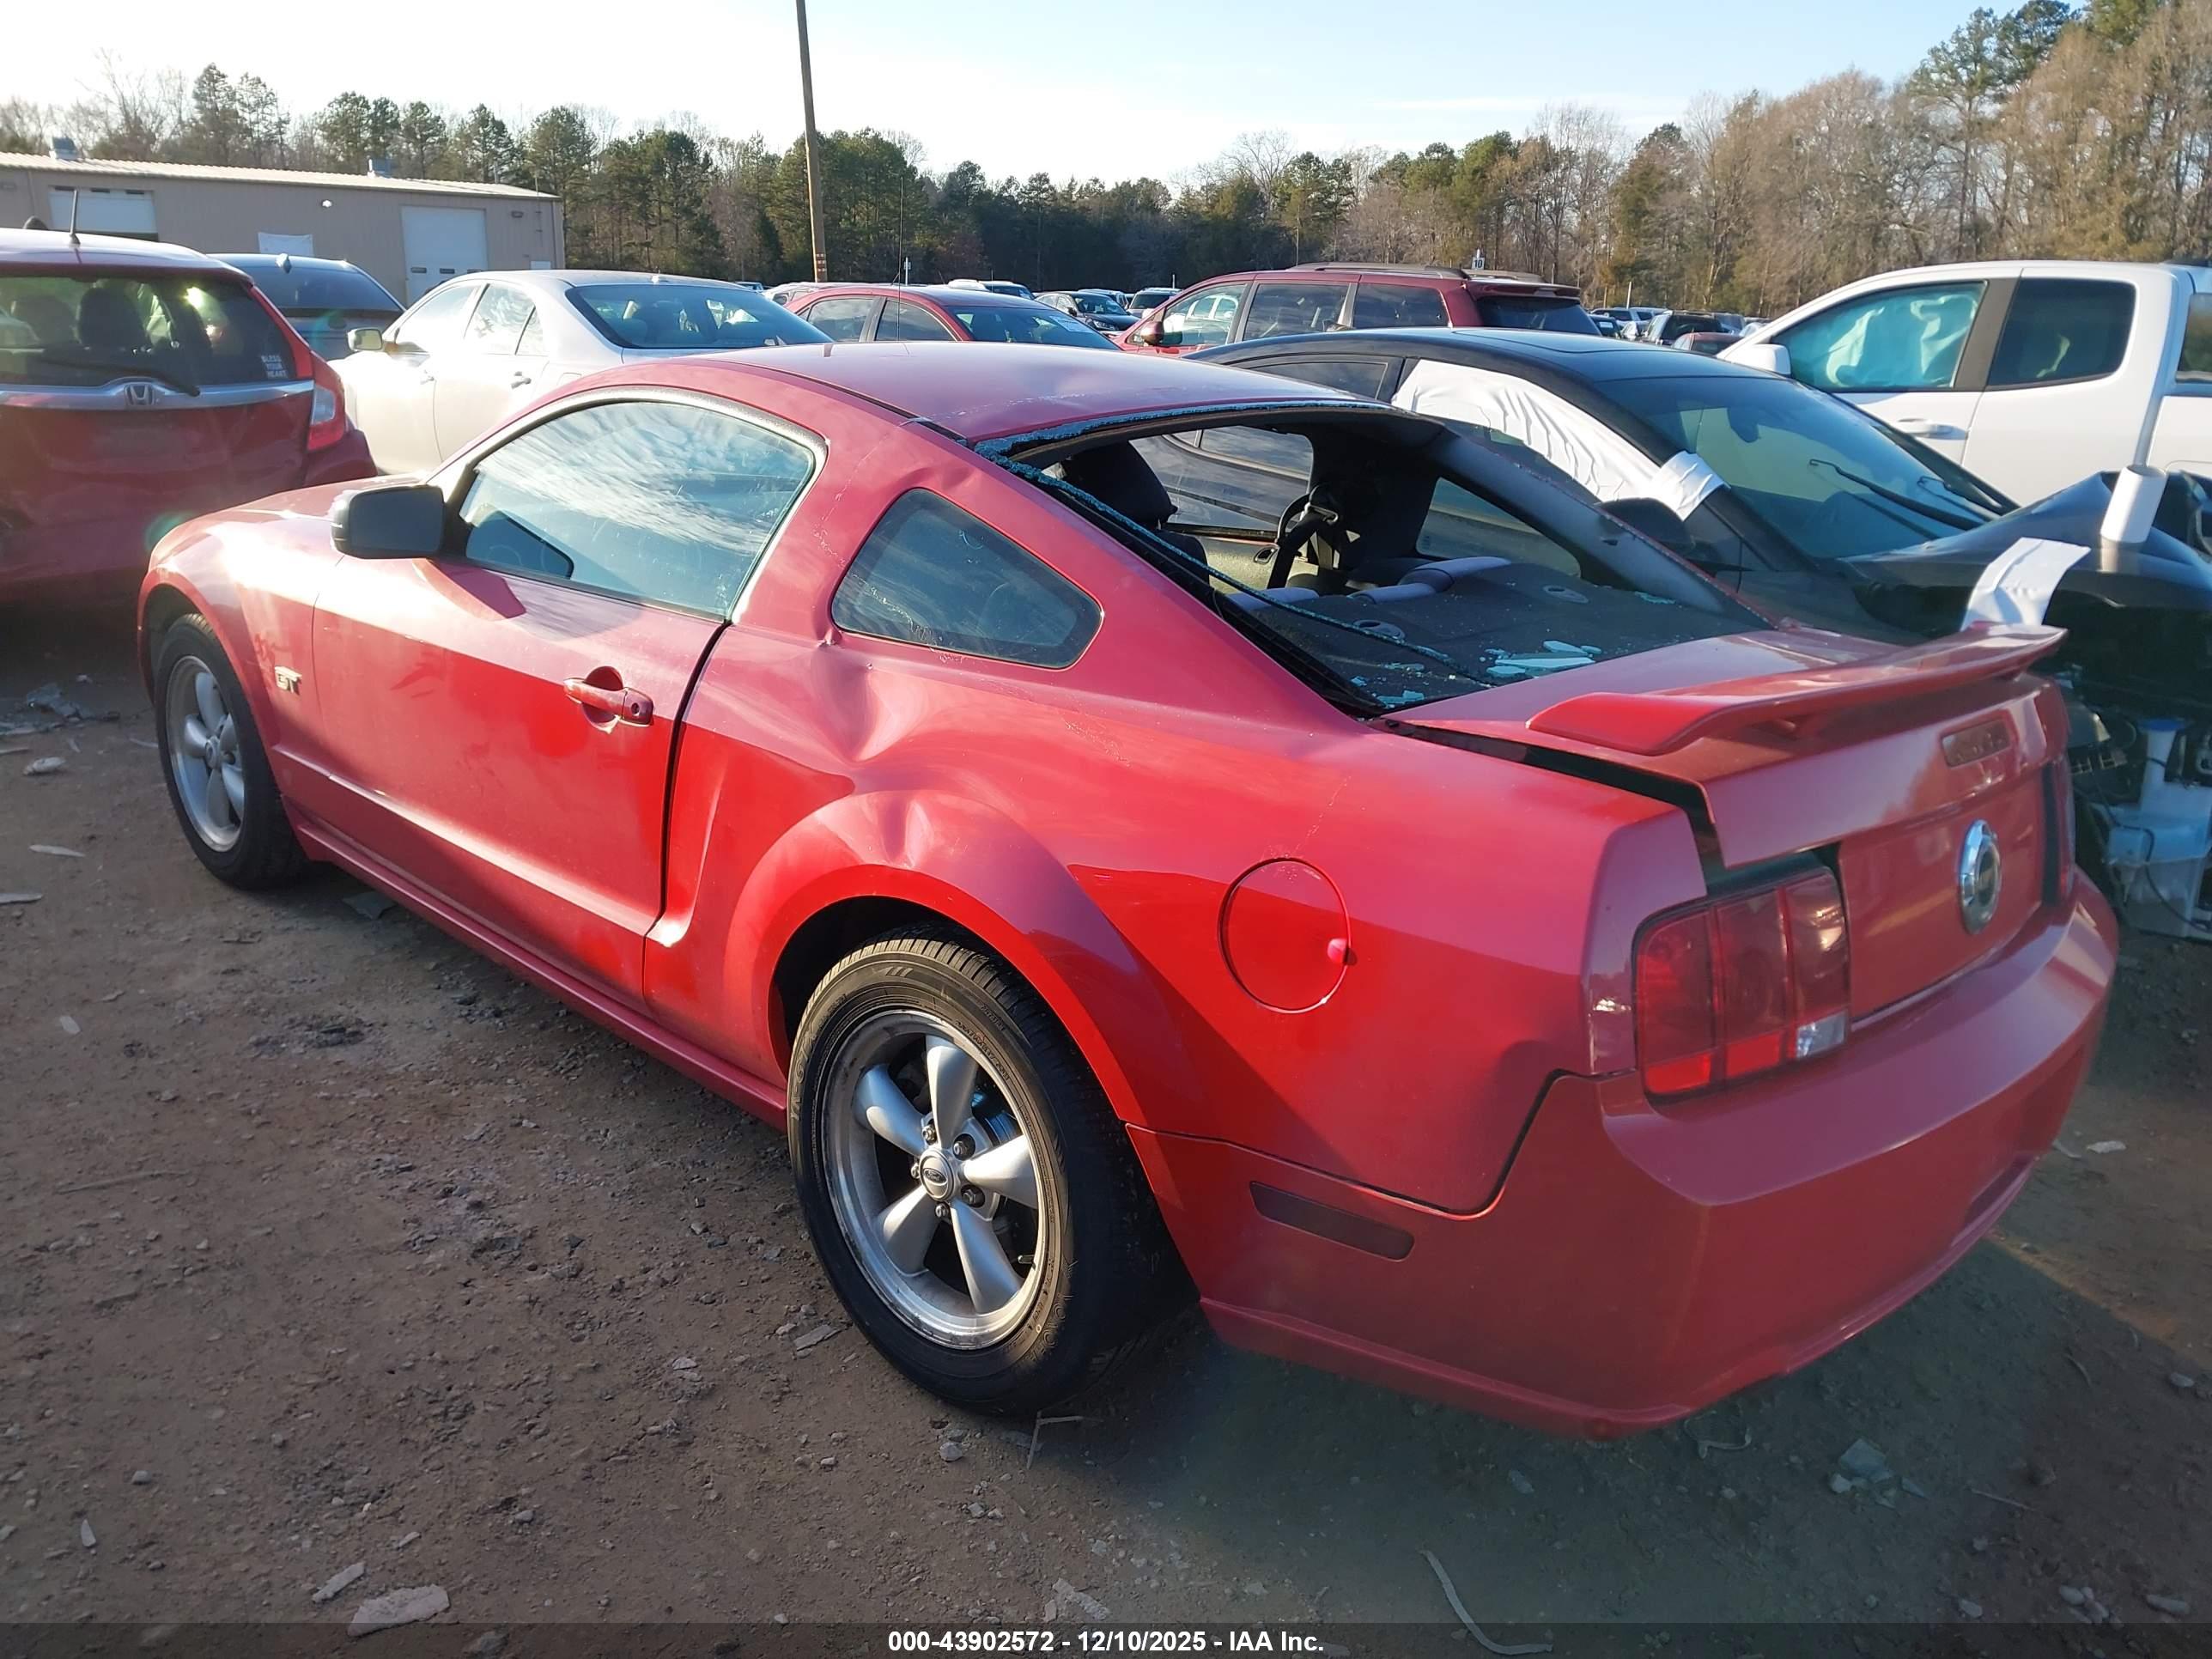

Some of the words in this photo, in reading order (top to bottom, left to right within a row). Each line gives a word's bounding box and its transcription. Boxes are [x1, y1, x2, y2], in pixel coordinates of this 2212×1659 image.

[1474, 259, 1483, 269] 10
[266, 370, 289, 379] HEART
[274, 665, 302, 695] GT
